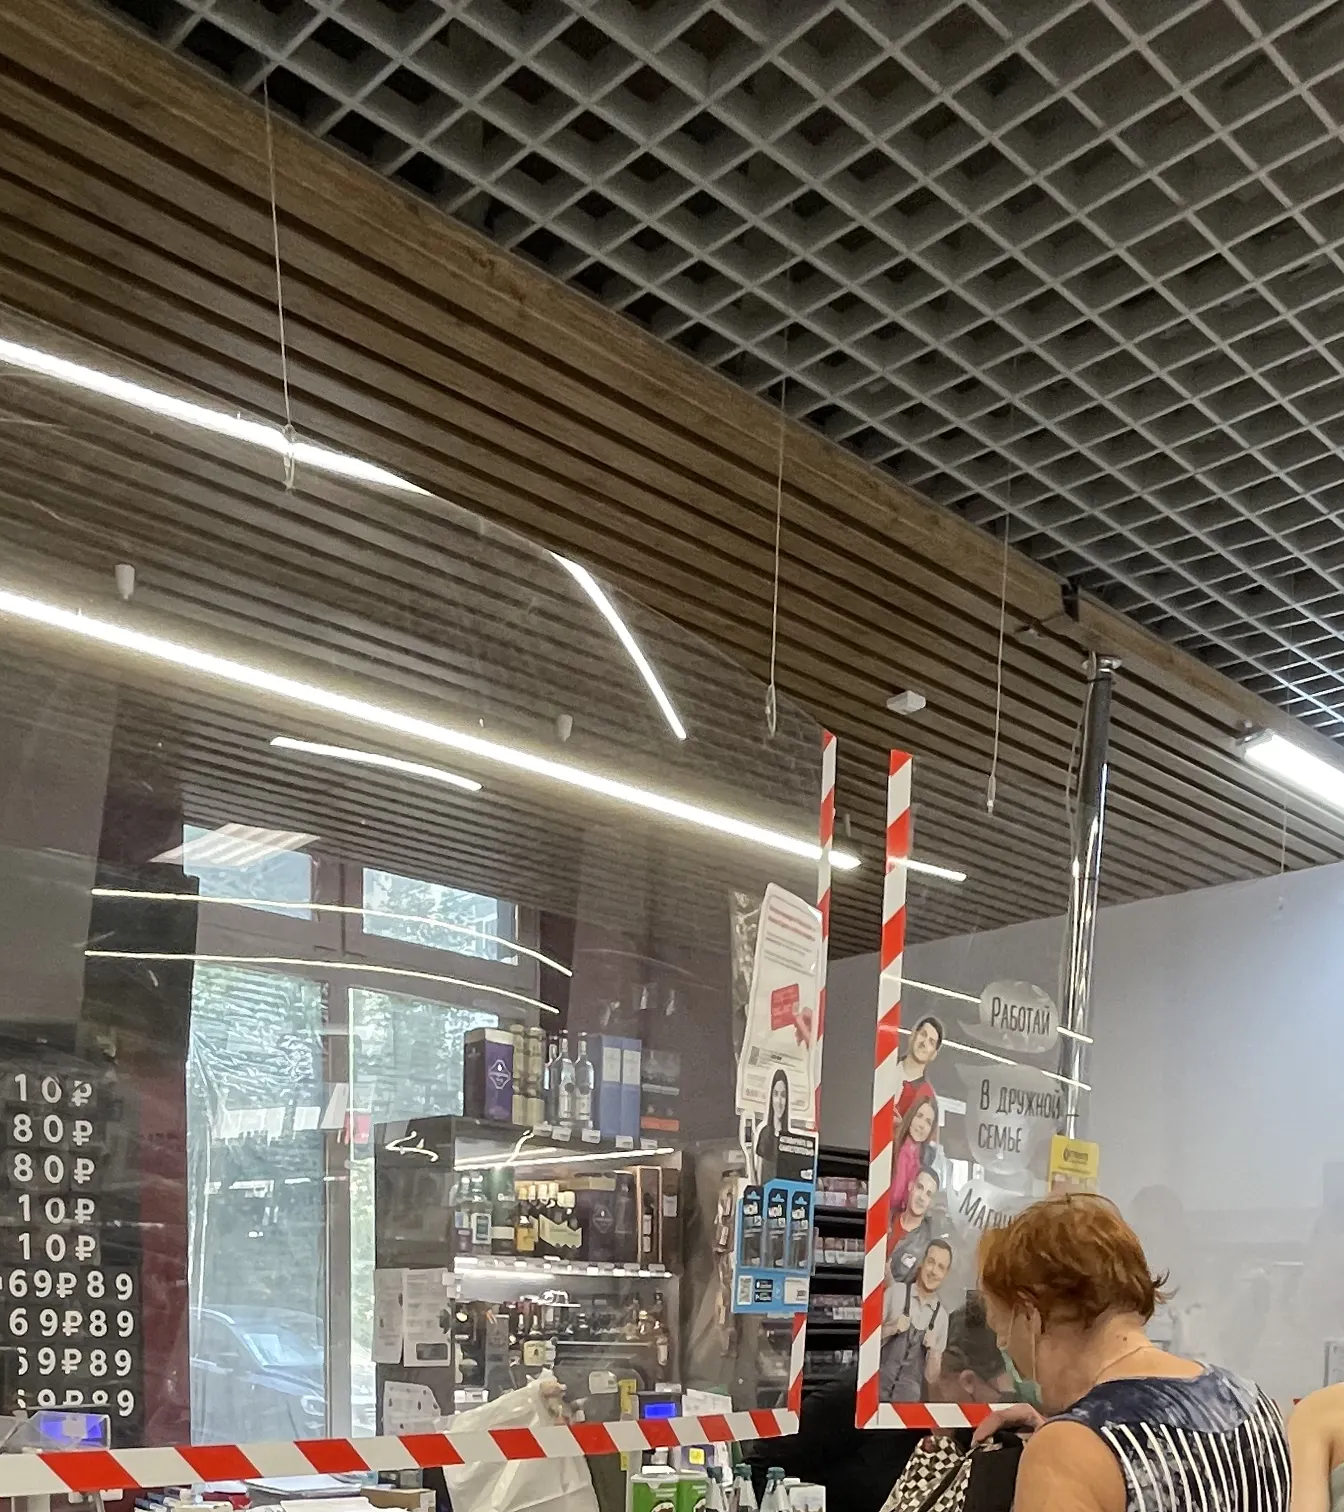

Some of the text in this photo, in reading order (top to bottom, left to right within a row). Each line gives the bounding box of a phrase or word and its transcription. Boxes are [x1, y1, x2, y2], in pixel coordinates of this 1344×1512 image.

[991, 997, 1051, 1037] РАБОТАЙ
[979, 1078, 1061, 1120] В ДРУЖНОЙ
[978, 1123, 1023, 1154] СЕМЬЕ
